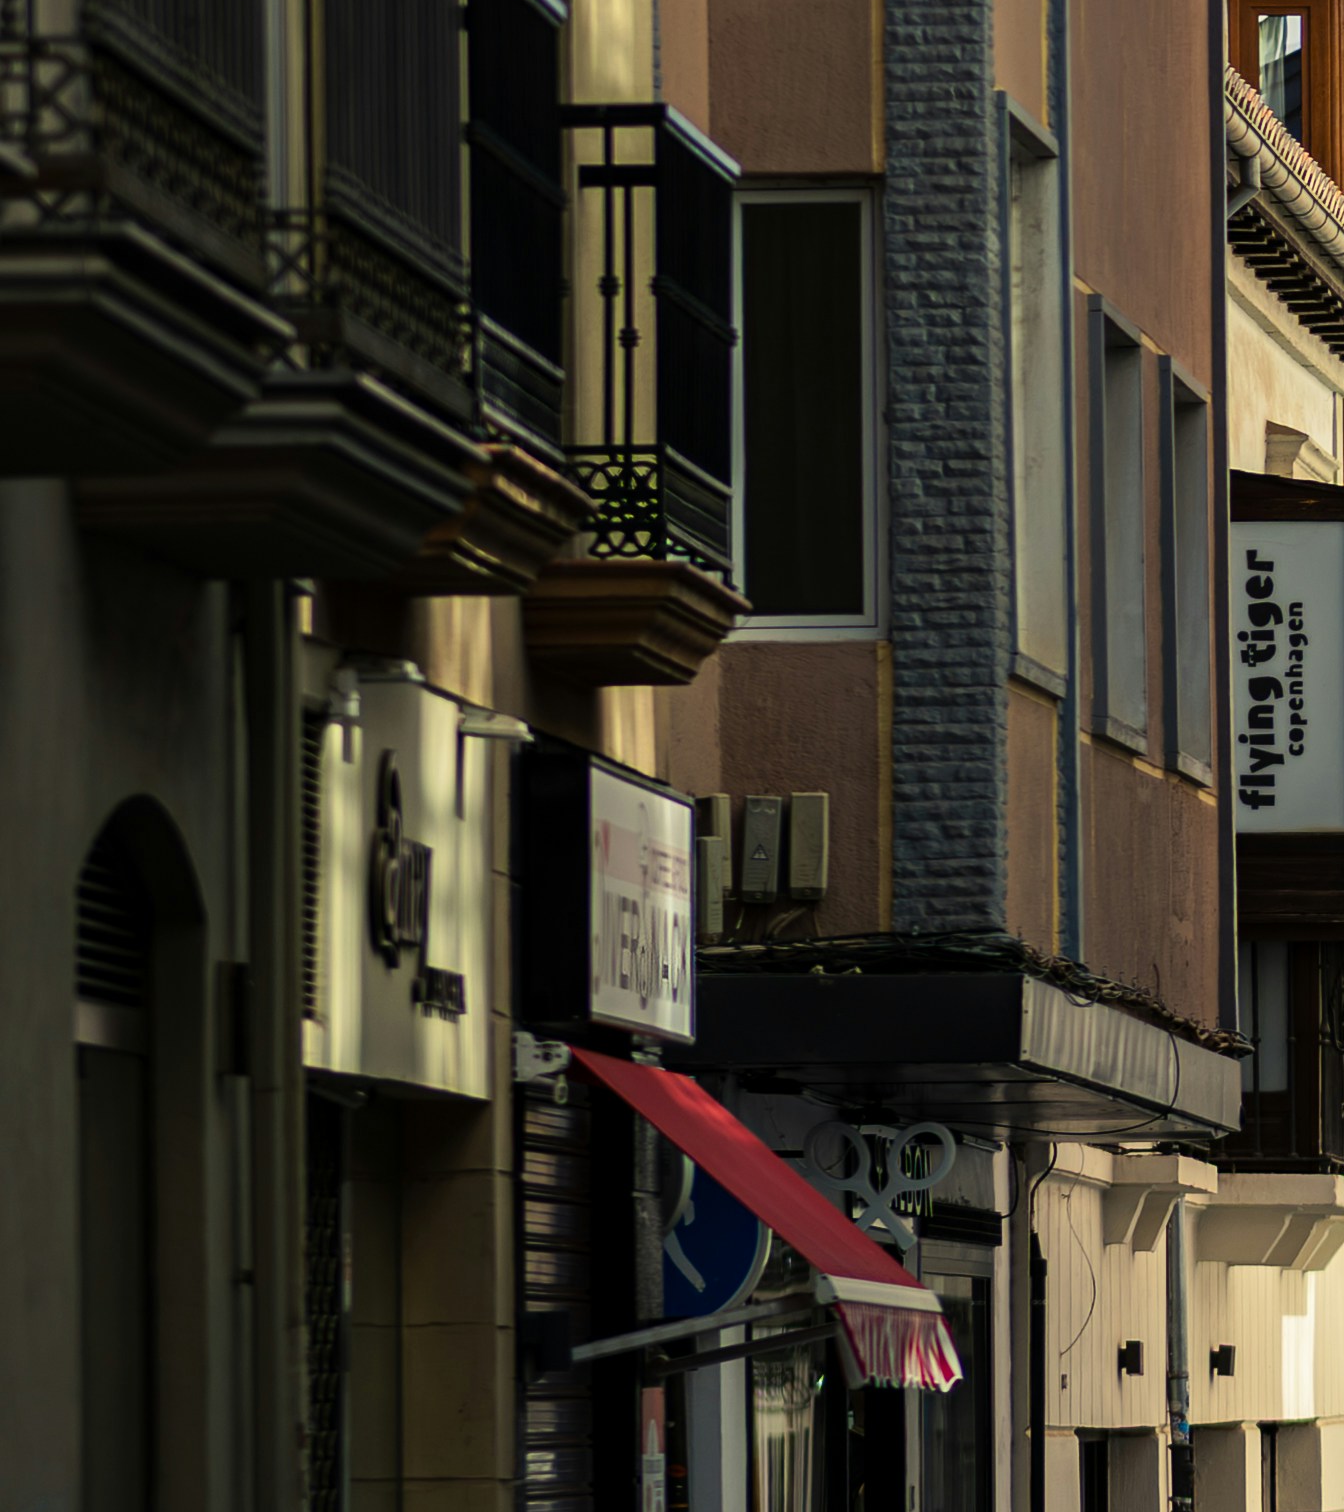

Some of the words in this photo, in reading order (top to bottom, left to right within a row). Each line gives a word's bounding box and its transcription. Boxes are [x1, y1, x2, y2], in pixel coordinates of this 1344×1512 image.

[1237, 549, 1284, 667] tiger
[1238, 676, 1284, 810] flying
[1285, 602, 1308, 756] copenhagen
